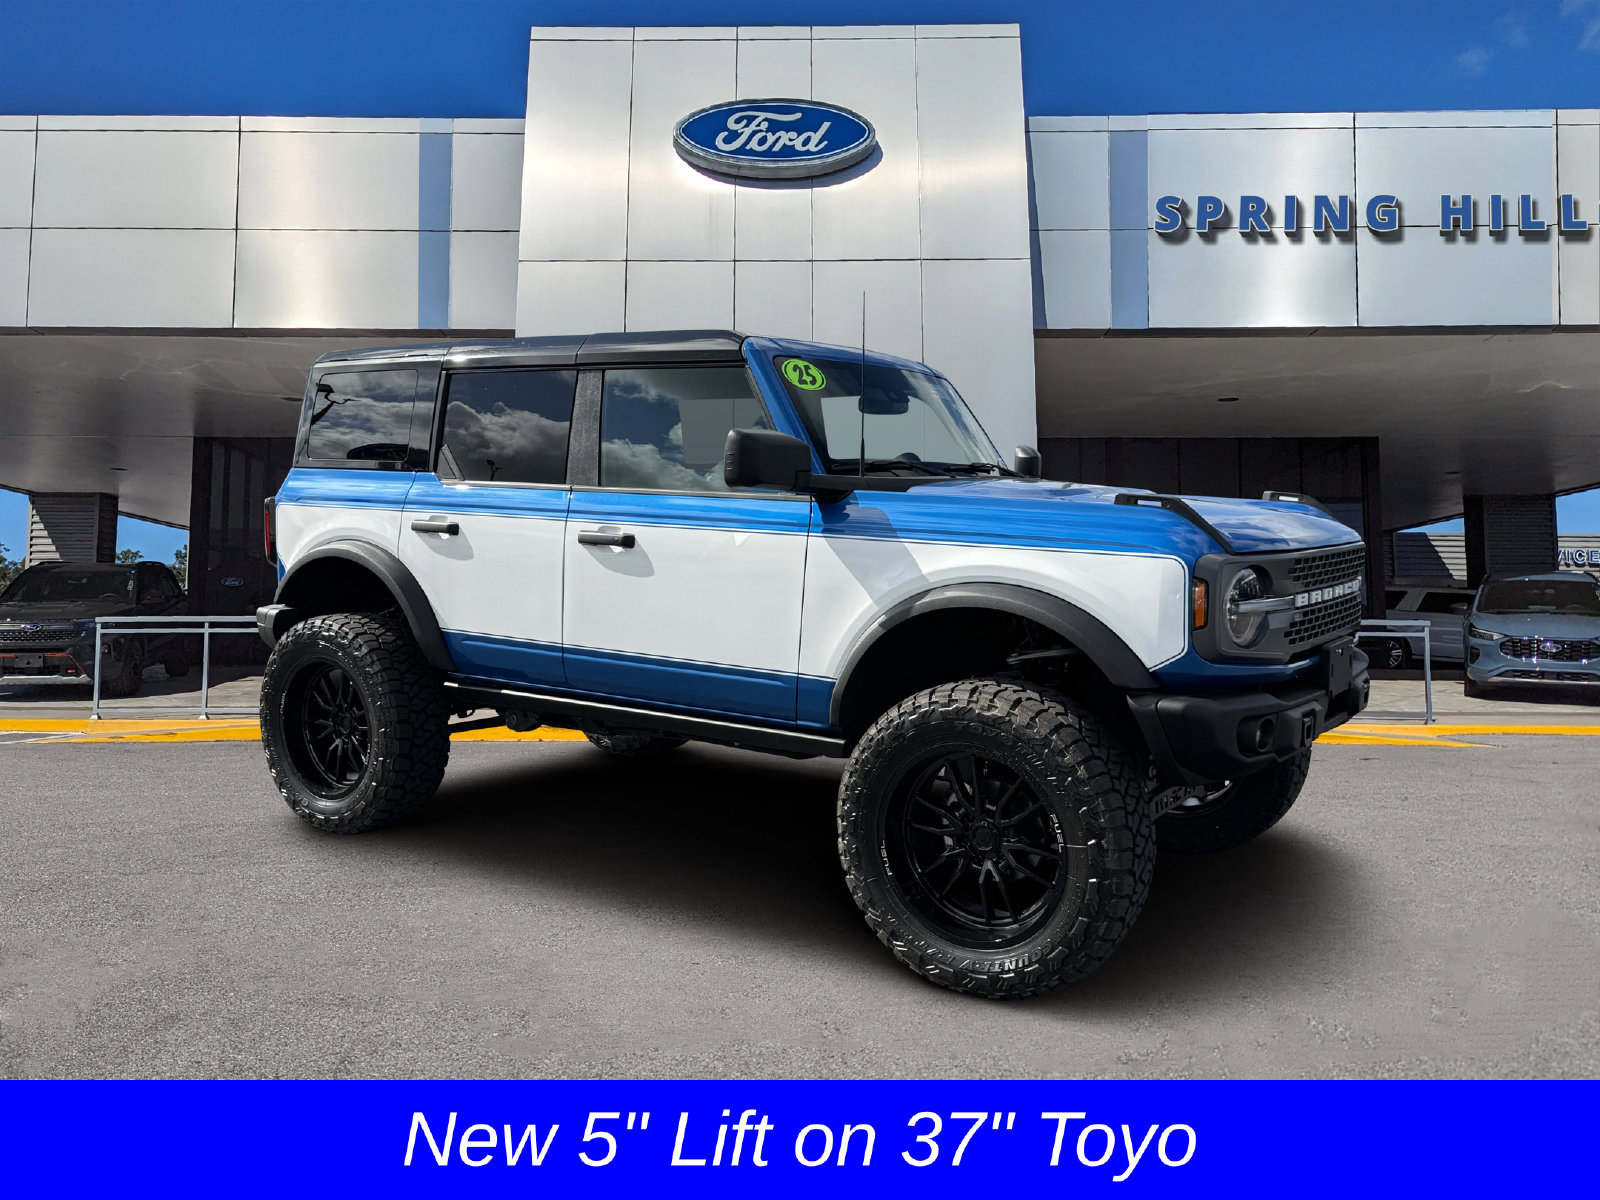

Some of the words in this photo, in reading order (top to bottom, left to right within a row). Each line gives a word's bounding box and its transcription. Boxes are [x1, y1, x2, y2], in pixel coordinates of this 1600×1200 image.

[715, 111, 832, 152] Ford
[1153, 194, 1400, 233] SPRING
[1439, 193, 1589, 232] HILL
[793, 364, 816, 387] 25
[1295, 579, 1361, 608] BRONCO
[1049, 813, 1065, 853] FUEL
[958, 938, 1053, 973] COUNTRY
